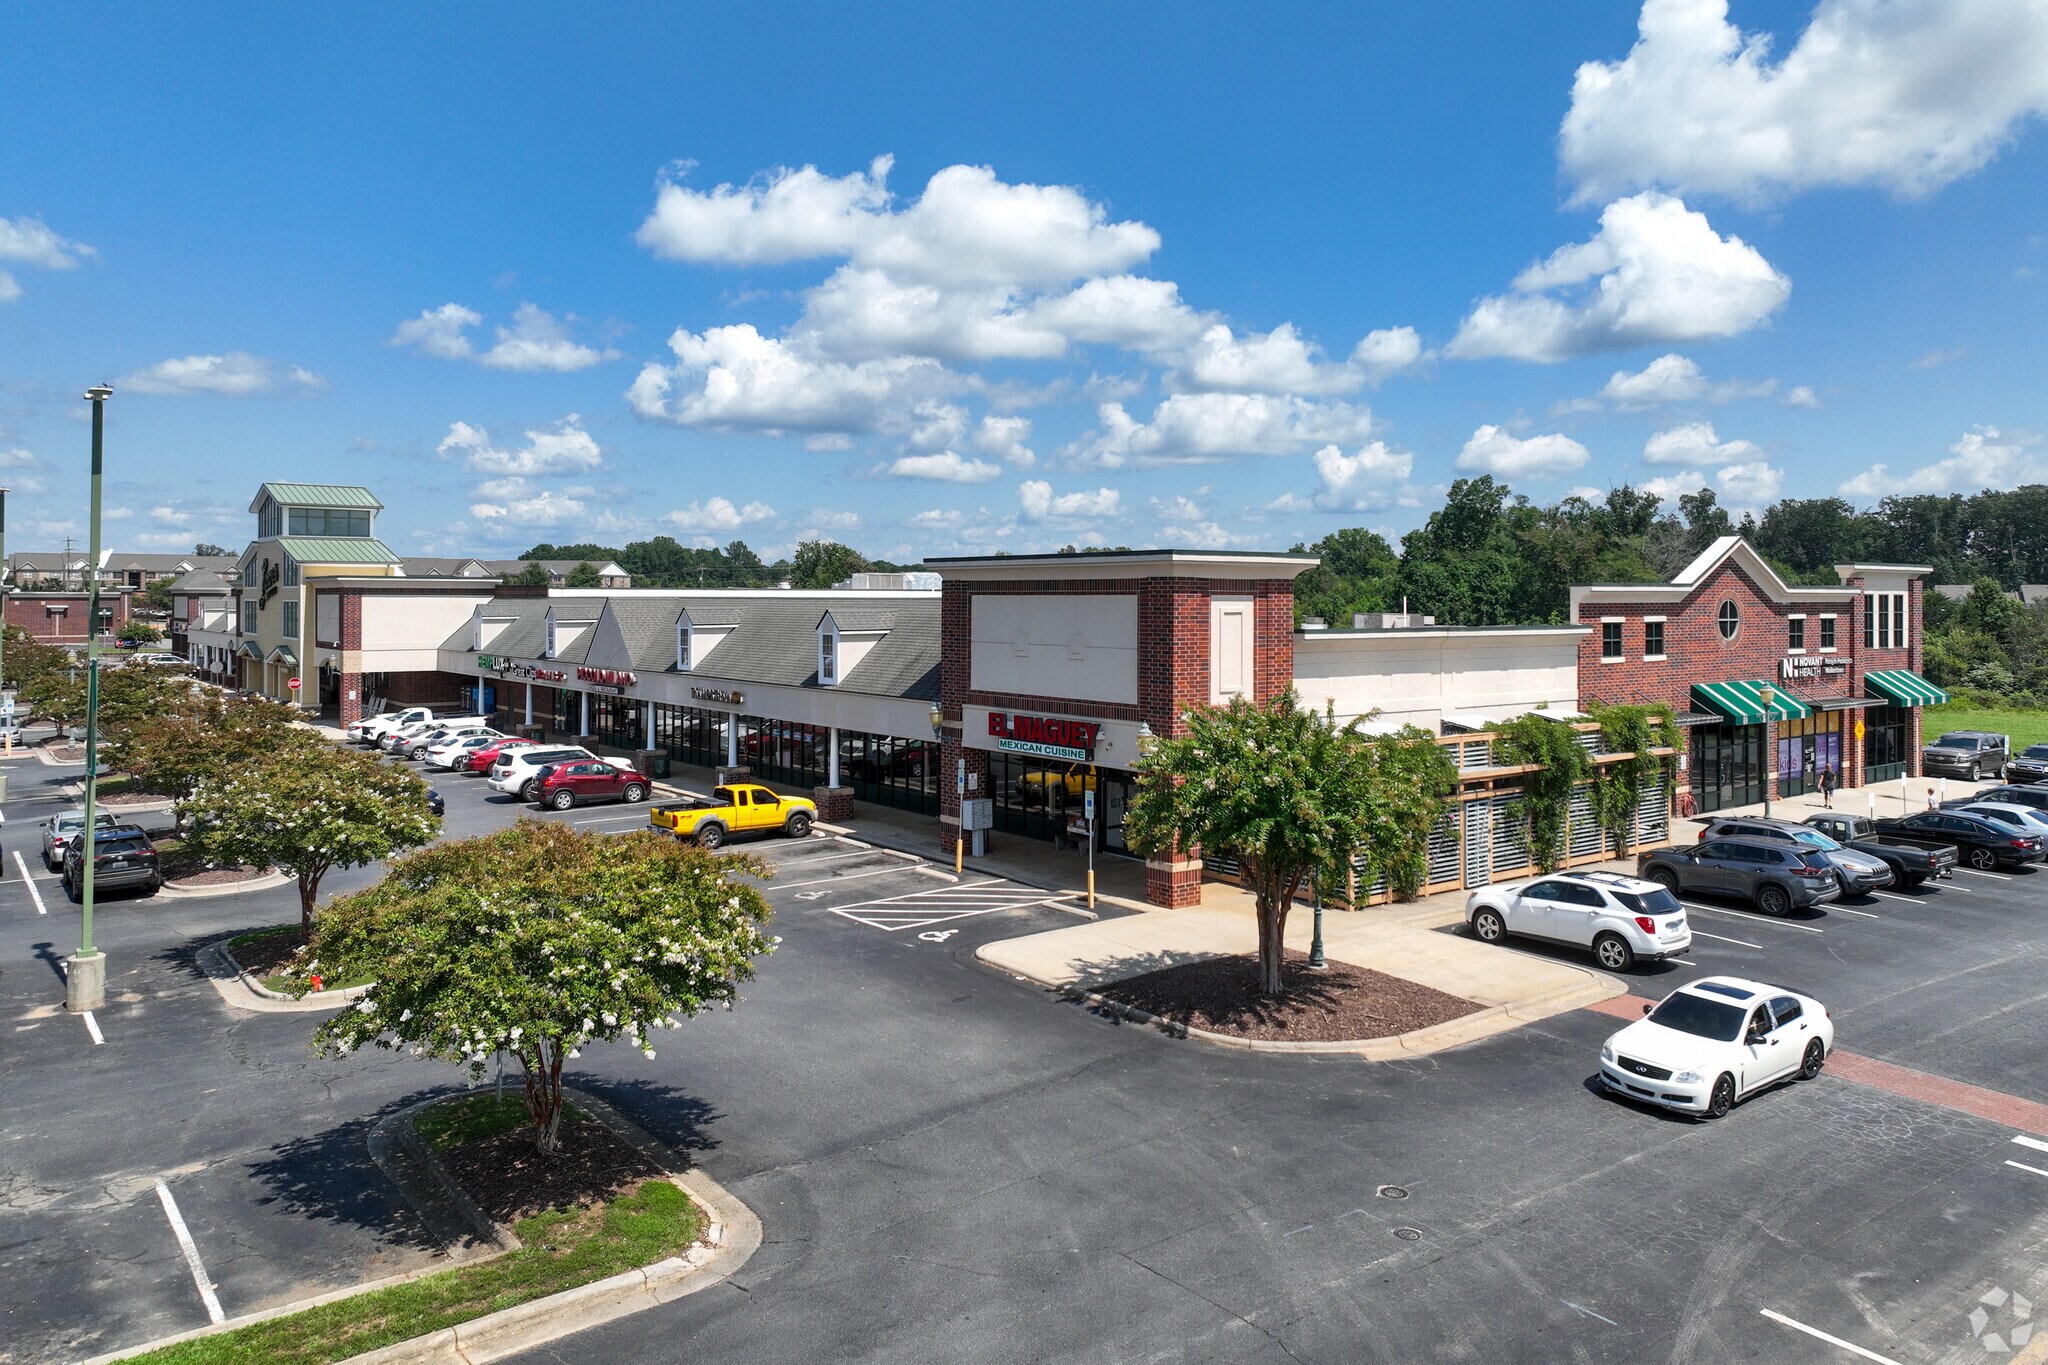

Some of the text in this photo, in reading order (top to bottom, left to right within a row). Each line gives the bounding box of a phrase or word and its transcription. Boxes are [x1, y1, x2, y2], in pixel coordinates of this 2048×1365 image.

[1800, 657, 1823, 666] NOVANT
[1800, 667, 1821, 677] HEALTH
[989, 712, 1100, 749] EL MAGUEY
[999, 739, 1085, 759] MEXICAN CUISINE
